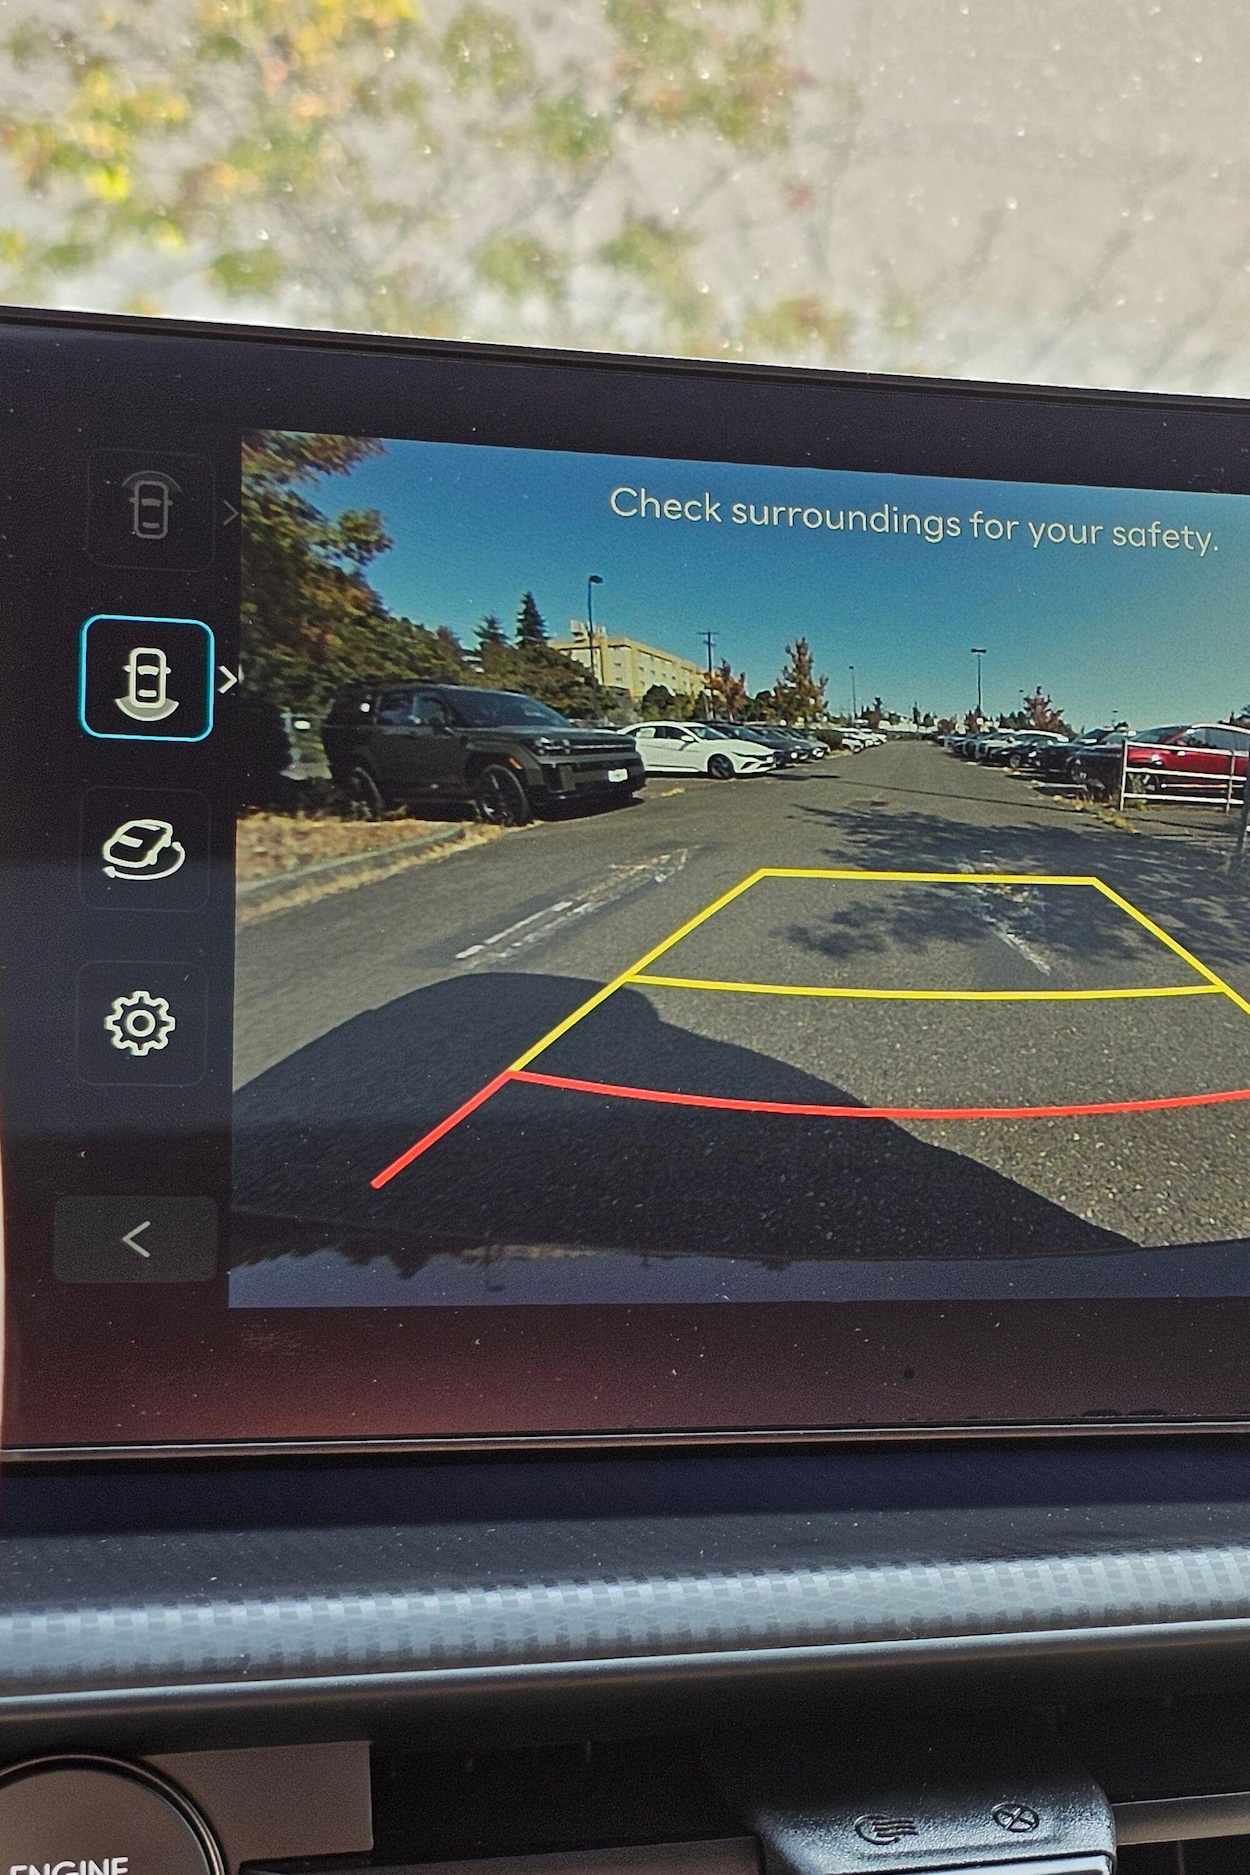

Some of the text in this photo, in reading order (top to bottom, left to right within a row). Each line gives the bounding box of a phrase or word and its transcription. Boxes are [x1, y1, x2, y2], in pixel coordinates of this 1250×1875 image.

[610, 487, 1220, 557] Check surroundings for your safety.
